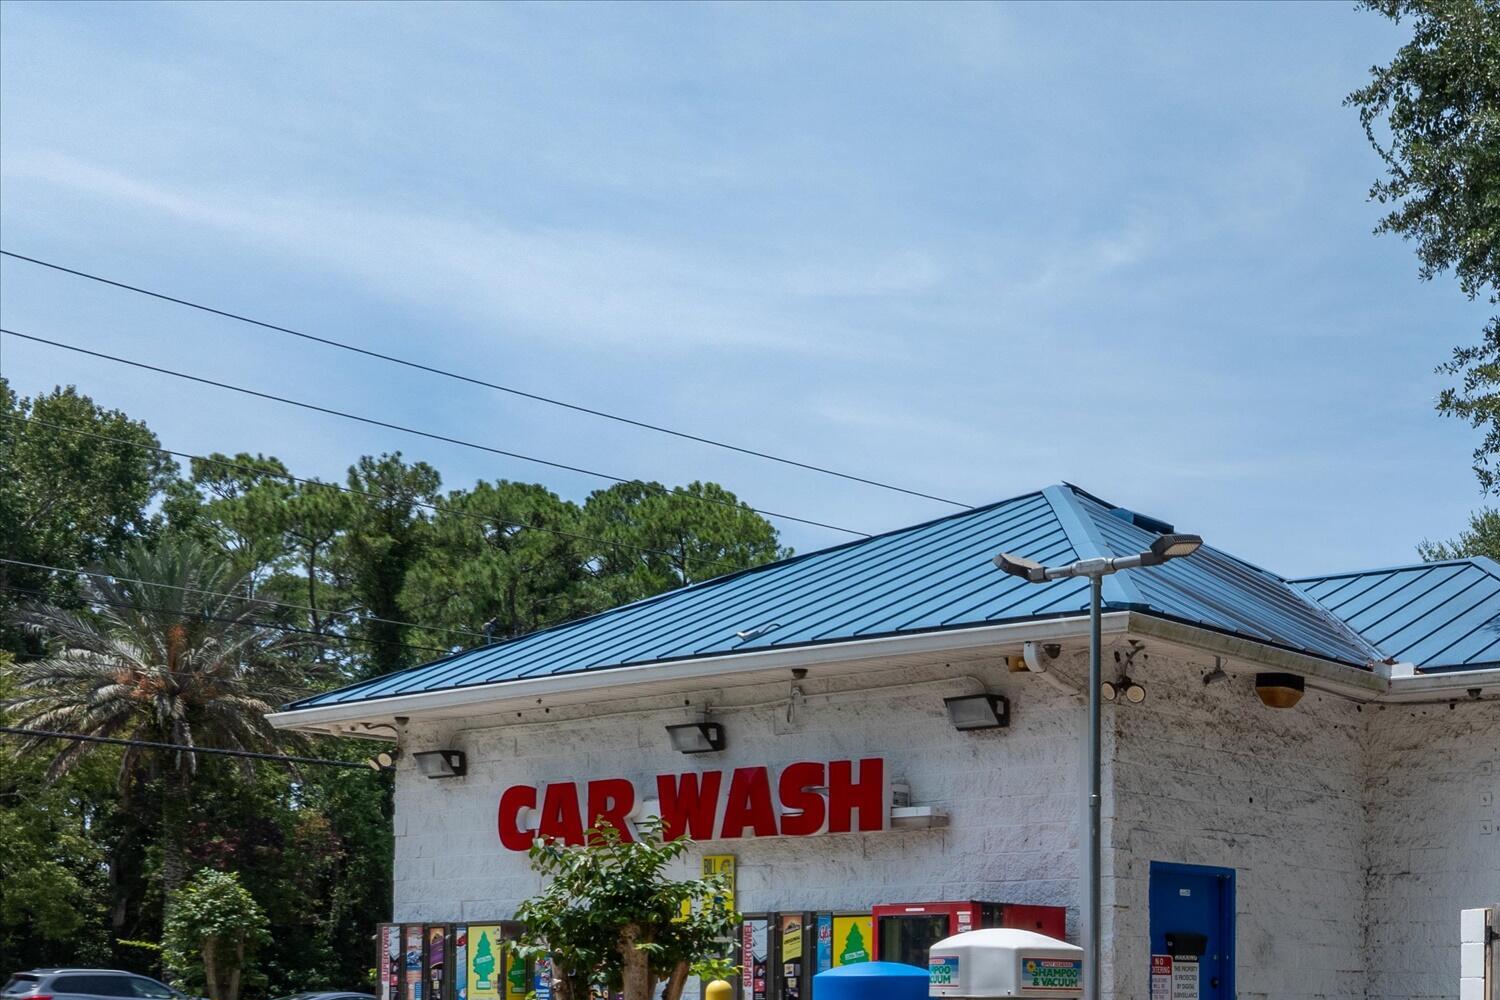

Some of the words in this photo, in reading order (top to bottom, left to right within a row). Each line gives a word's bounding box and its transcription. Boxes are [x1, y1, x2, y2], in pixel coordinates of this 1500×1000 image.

[497, 778, 634, 852] CAR
[656, 758, 883, 843] WASH
[743, 922, 752, 987] SUPERTOWEL
[1154, 958, 1163, 966] NO
[1032, 968, 1077, 977] SHAMPOO
[1152, 966, 1170, 974] OITERING
[1033, 978, 1039, 986] &
[1042, 978, 1077, 987] VACUUM
